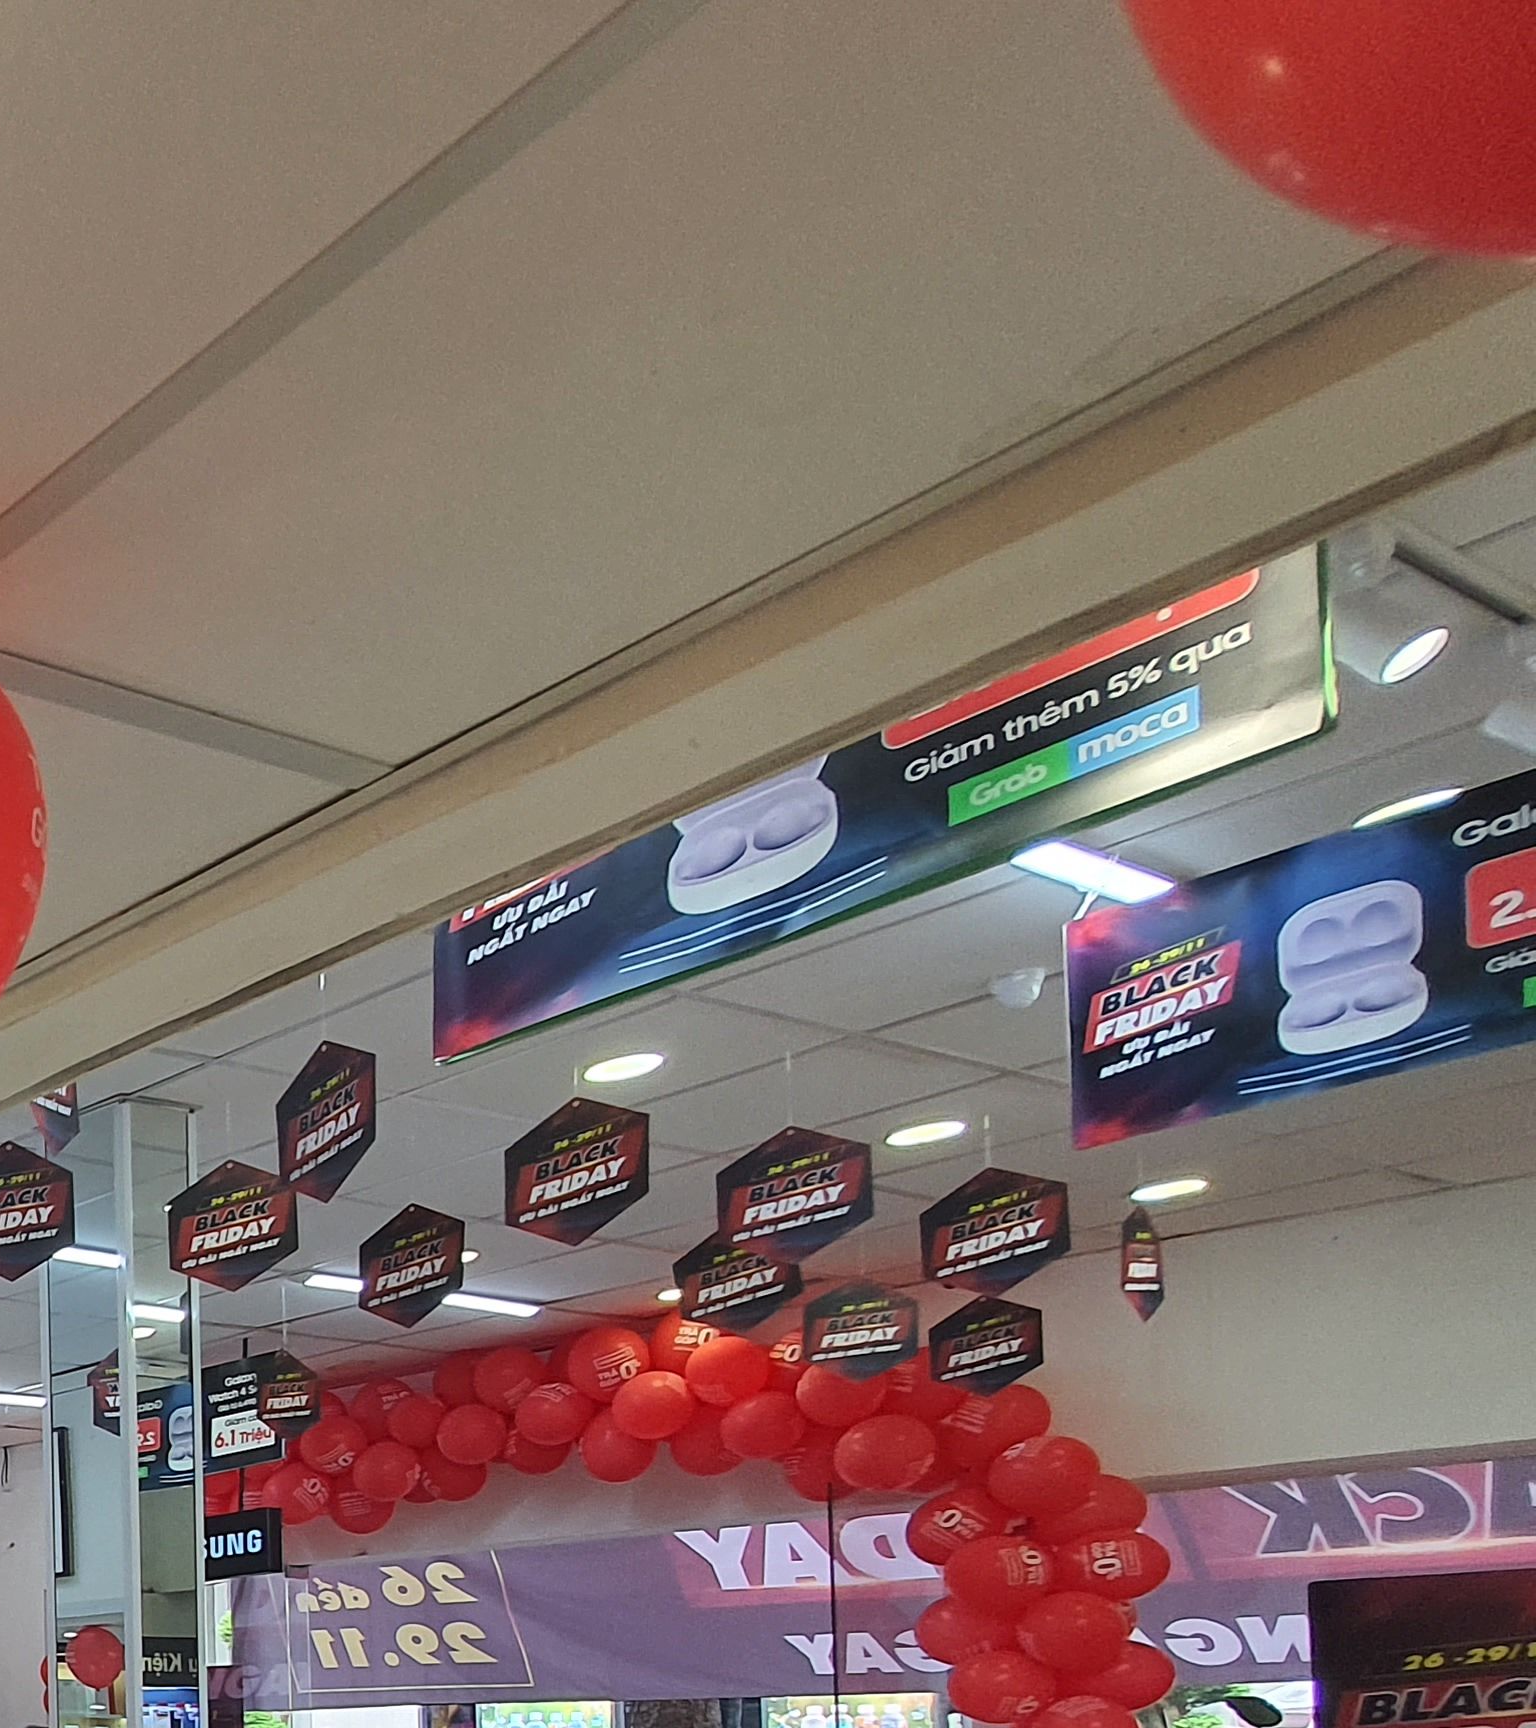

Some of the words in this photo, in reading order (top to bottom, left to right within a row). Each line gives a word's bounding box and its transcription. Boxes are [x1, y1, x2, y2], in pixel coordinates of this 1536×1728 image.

[903, 729, 996, 784] Giảm
[1002, 683, 1100, 743] thêm
[1106, 656, 1164, 699] 5%
[1169, 621, 1254, 675] qua
[969, 761, 1048, 807] Grab
[1076, 698, 1190, 763] moca
[527, 879, 569, 915] ĐÃI
[529, 887, 598, 935] NGAY
[1100, 948, 1223, 1016] BLACK
[1093, 975, 1231, 1047] FRIDAY
[1158, 1028, 1216, 1064] NGAY
[299, 1080, 358, 1135] BLACK
[295, 1102, 362, 1161] FRIDAY
[535, 1136, 623, 1182] BLACK
[528, 1155, 626, 1205] FRIDAY
[747, 1163, 841, 1203] BLACK
[195, 1199, 270, 1232] BLACK
[741, 1184, 847, 1225] FRIDAY
[949, 1201, 1039, 1242] BLACK
[189, 1216, 277, 1254] FRIDAY
[944, 1218, 1046, 1262] FRIDAY
[375, 1255, 447, 1293] FRIDAY
[380, 1238, 443, 1273] BLACK
[700, 1255, 770, 1286] BLACK
[697, 1267, 779, 1304] FRIDAY
[819, 1324, 902, 1349] FRIDAY
[826, 1309, 896, 1332] BLACK
[952, 1323, 1019, 1352] BLACK
[946, 1337, 1024, 1368] FRIDAY
[265, 1394, 309, 1410] FRIDAY
[215, 1429, 236, 1448] 6.1
[239, 1427, 271, 1443] Triệu
[1356, 1677, 1536, 1728] BLAC
